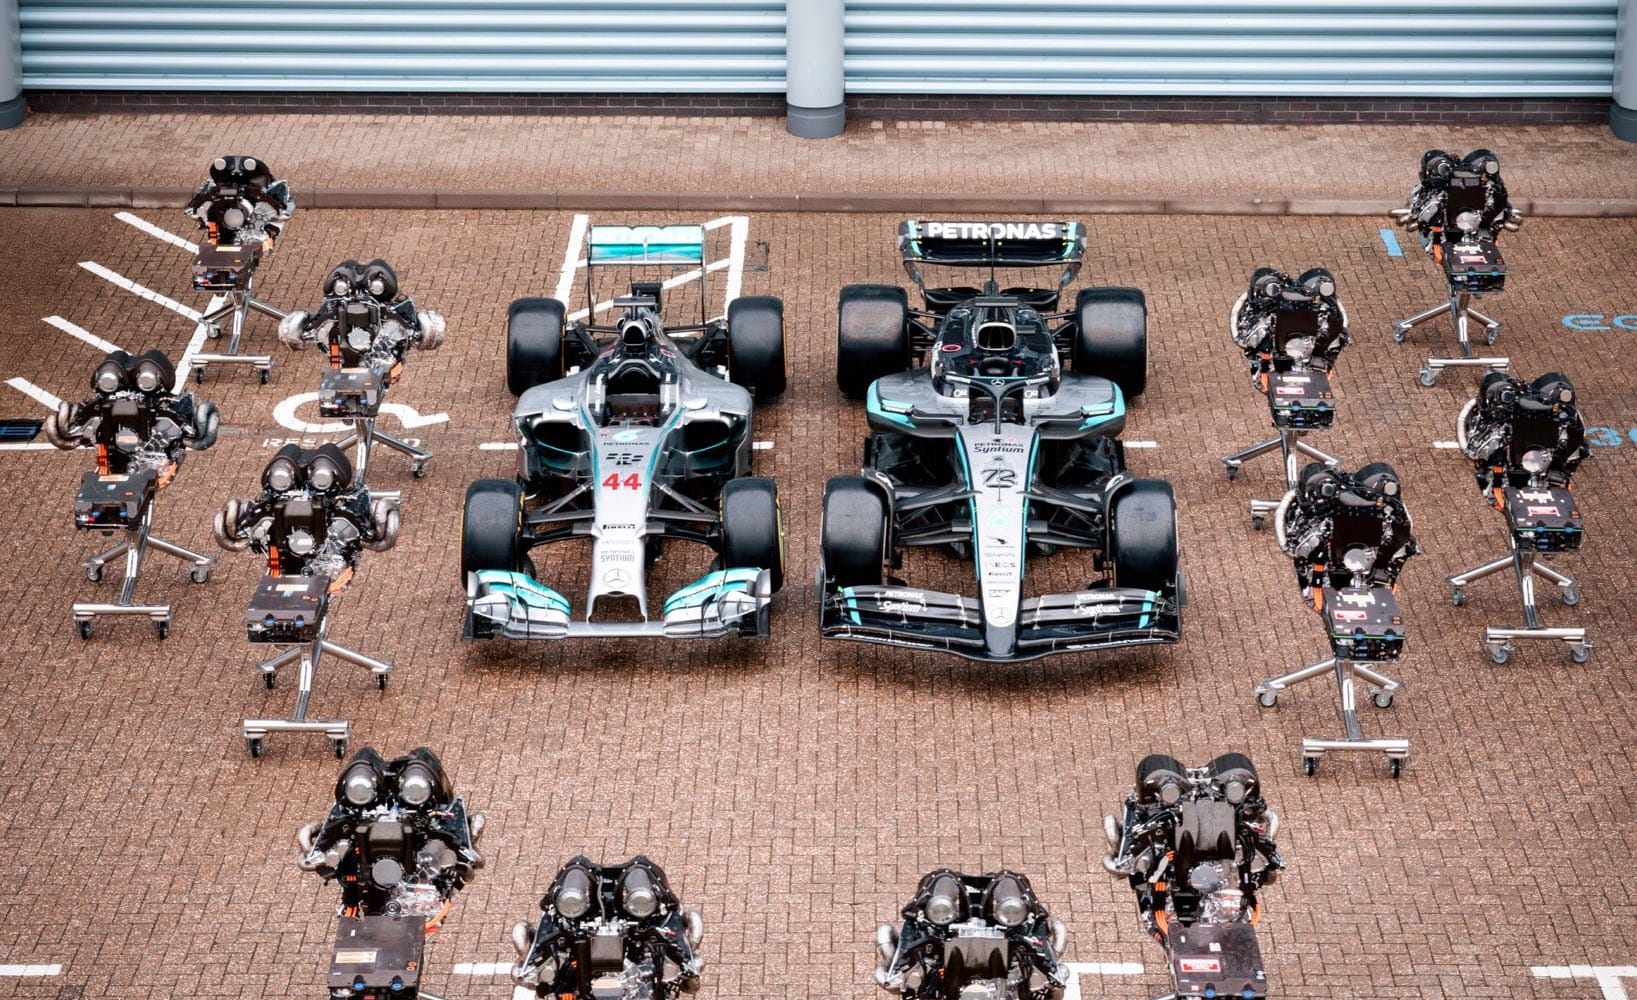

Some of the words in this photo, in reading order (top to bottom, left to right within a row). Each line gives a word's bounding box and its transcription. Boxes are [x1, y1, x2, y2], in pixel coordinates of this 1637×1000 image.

[928, 222, 1057, 240] PETRONAS
[602, 473, 642, 490] 44
[600, 554, 635, 563] SYNTIUM
